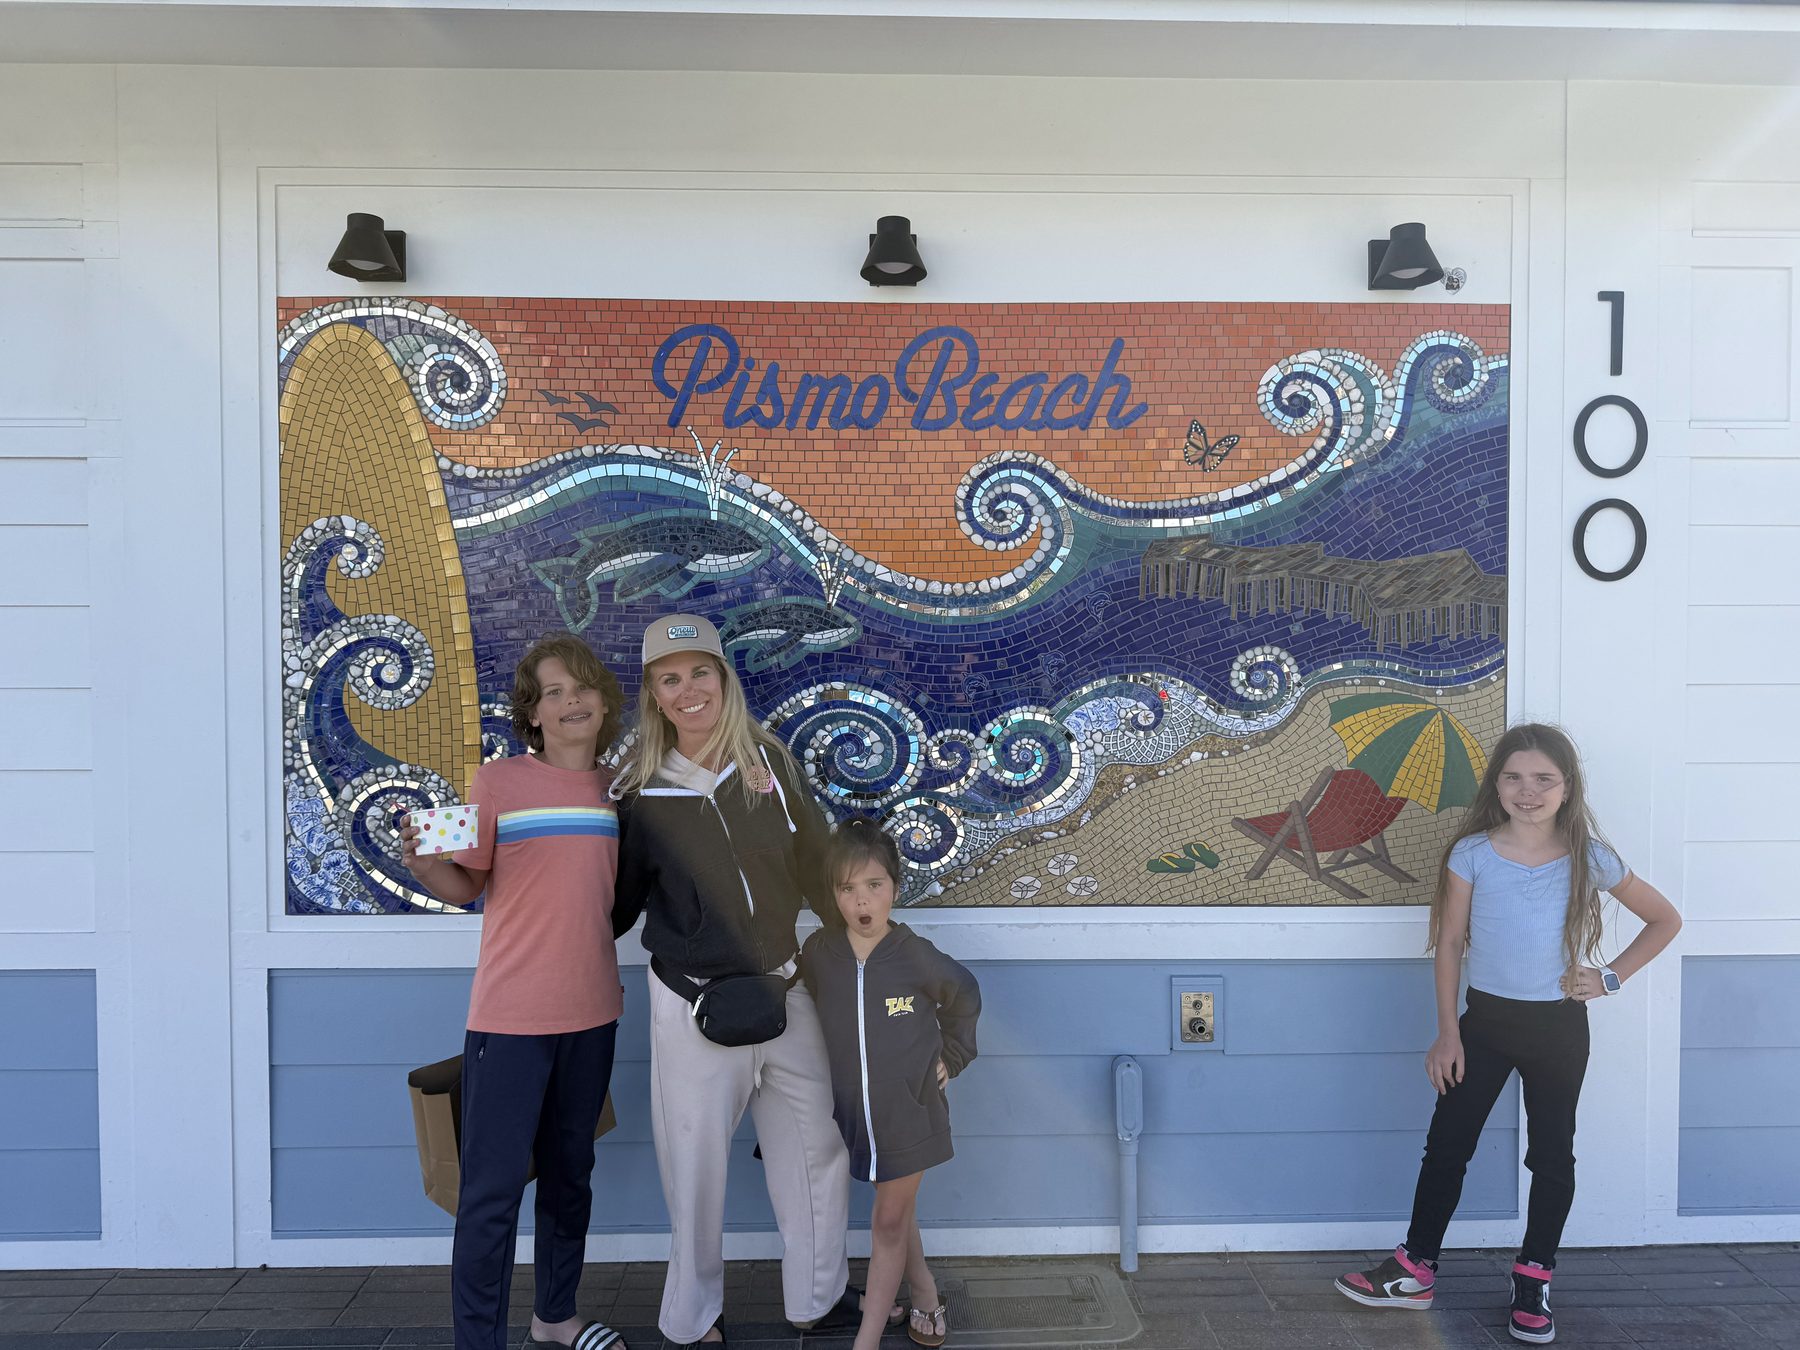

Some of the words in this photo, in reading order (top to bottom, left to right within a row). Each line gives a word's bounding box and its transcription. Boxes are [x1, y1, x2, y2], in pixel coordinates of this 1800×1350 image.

[652, 323, 890, 430] Pismo
[894, 325, 1149, 431] Beach
[1572, 291, 1648, 582] 100
[886, 996, 914, 1016] TAZ
